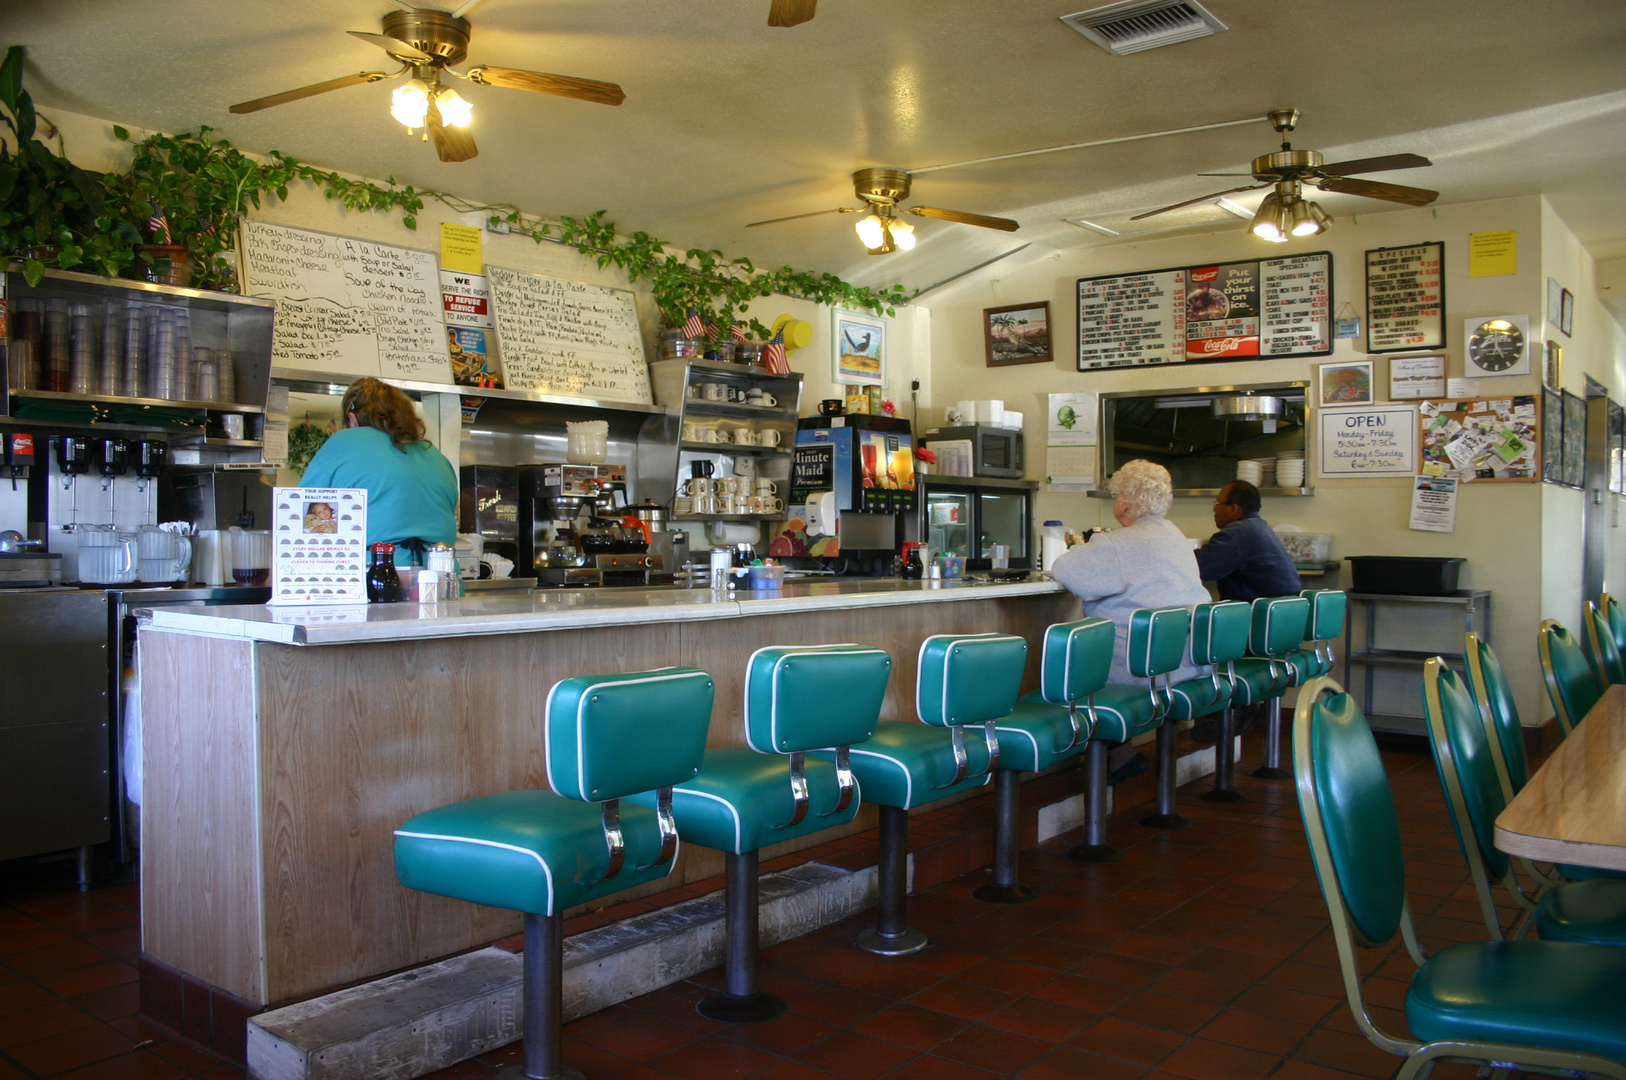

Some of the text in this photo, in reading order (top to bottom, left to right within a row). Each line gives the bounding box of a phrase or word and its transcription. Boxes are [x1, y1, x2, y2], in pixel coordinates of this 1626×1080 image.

[246, 234, 269, 250] Pork
[345, 241, 355, 254] A
[359, 243, 370, 255] la
[374, 244, 401, 262] Carte
[1379, 248, 1427, 259] SPECIALS
[248, 249, 330, 272] Macaroni Cheese
[342, 254, 358, 262] with
[360, 256, 380, 266] Soup
[1291, 256, 1323, 264] BREAKFAST
[251, 262, 297, 278] Meatloaf
[362, 266, 394, 276] dessert
[1229, 269, 1250, 277] Put
[1388, 263, 1410, 271] COFFEE
[250, 275, 308, 293] Swordfish
[345, 272, 370, 286] Soup
[376, 279, 386, 288] of
[390, 282, 404, 292] the
[454, 276, 470, 286] WE
[488, 268, 514, 280] Veggie
[516, 272, 542, 286] burger
[567, 282, 586, 292] Carte
[1226, 277, 1252, 286] your
[362, 289, 396, 301] Chicken
[442, 285, 489, 297] SERVE THE RIGHT
[1224, 285, 1256, 294] thirst
[444, 294, 482, 306] TO REFUSE
[368, 302, 394, 312] Cream
[450, 304, 476, 312] SERVICE
[447, 312, 478, 322] TO ANYONE
[274, 330, 298, 338] Salad
[1204, 338, 1238, 352] Coca-Cola
[290, 350, 318, 360] Tomato
[1345, 414, 1386, 428] OPEN
[1333, 449, 1367, 460] Saturday
[1374, 449, 1404, 460] Sunday
[795, 463, 824, 476] Maid
[478, 489, 502, 512] Fresh
